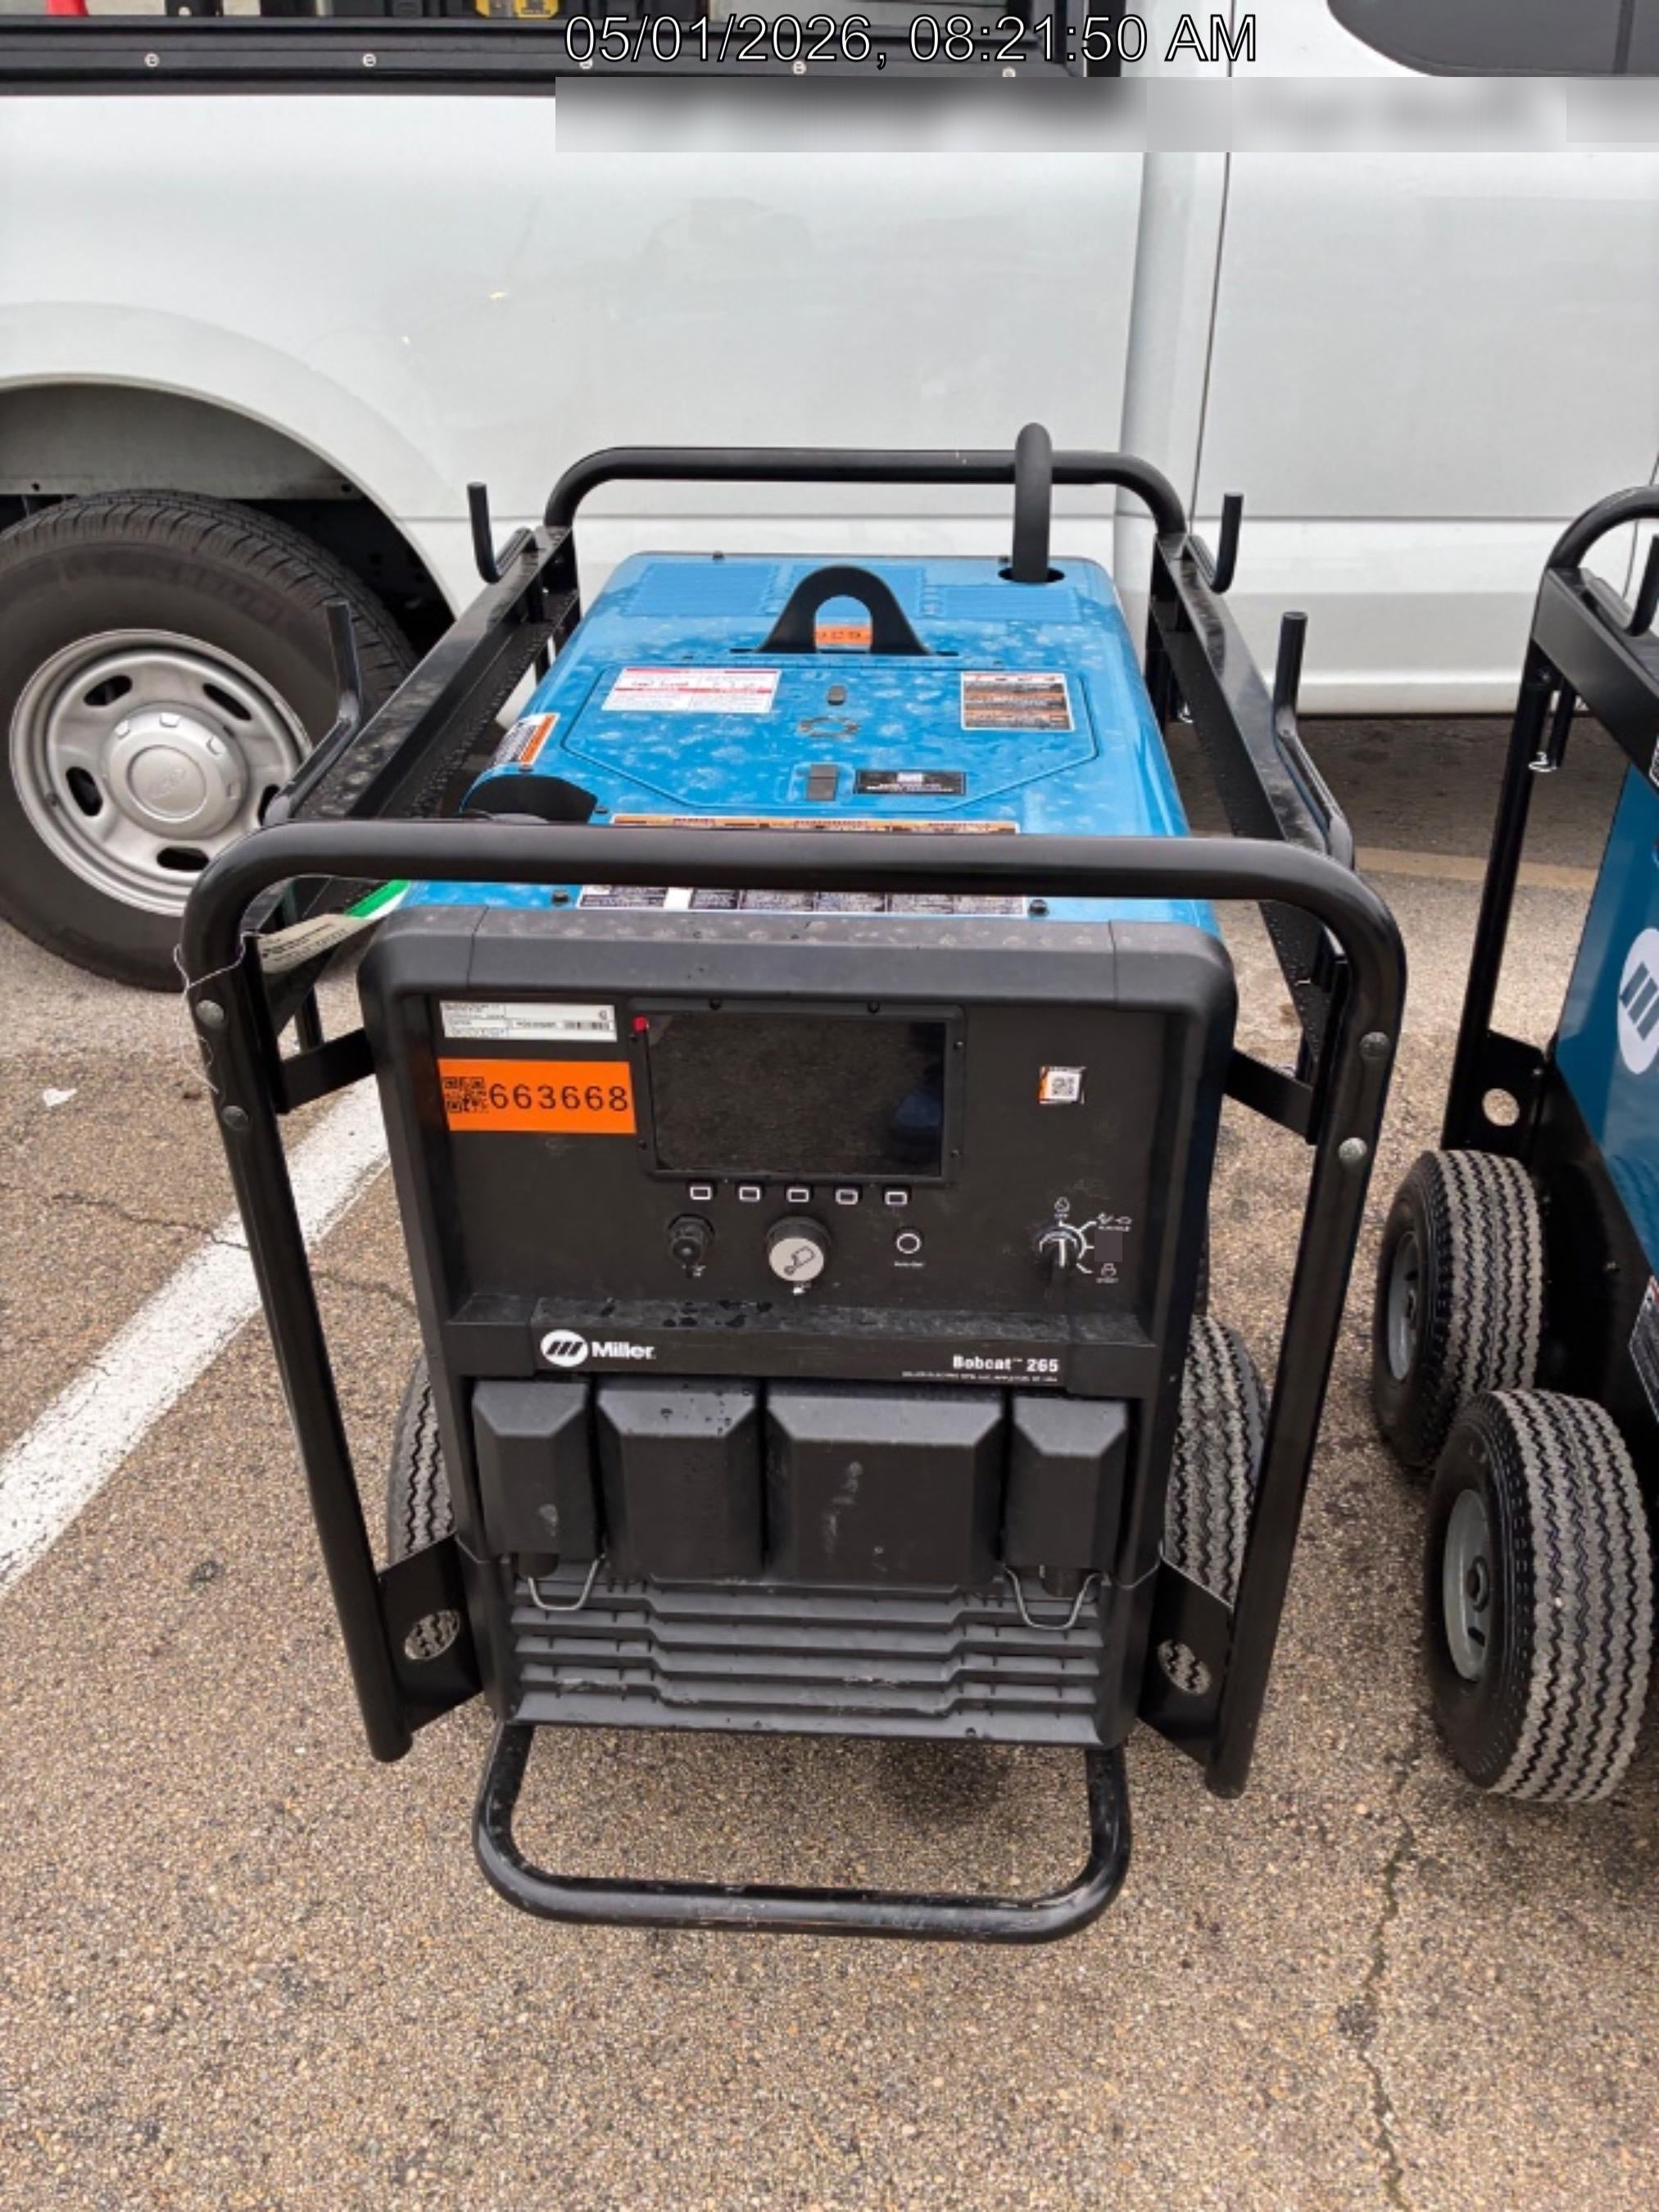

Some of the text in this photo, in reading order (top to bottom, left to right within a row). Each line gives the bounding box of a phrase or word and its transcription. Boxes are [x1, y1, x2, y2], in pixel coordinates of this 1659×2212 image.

[489, 1083, 628, 1112] 663668
[592, 1341, 655, 1360] Miller
[1027, 1358, 1058, 1373] 265
